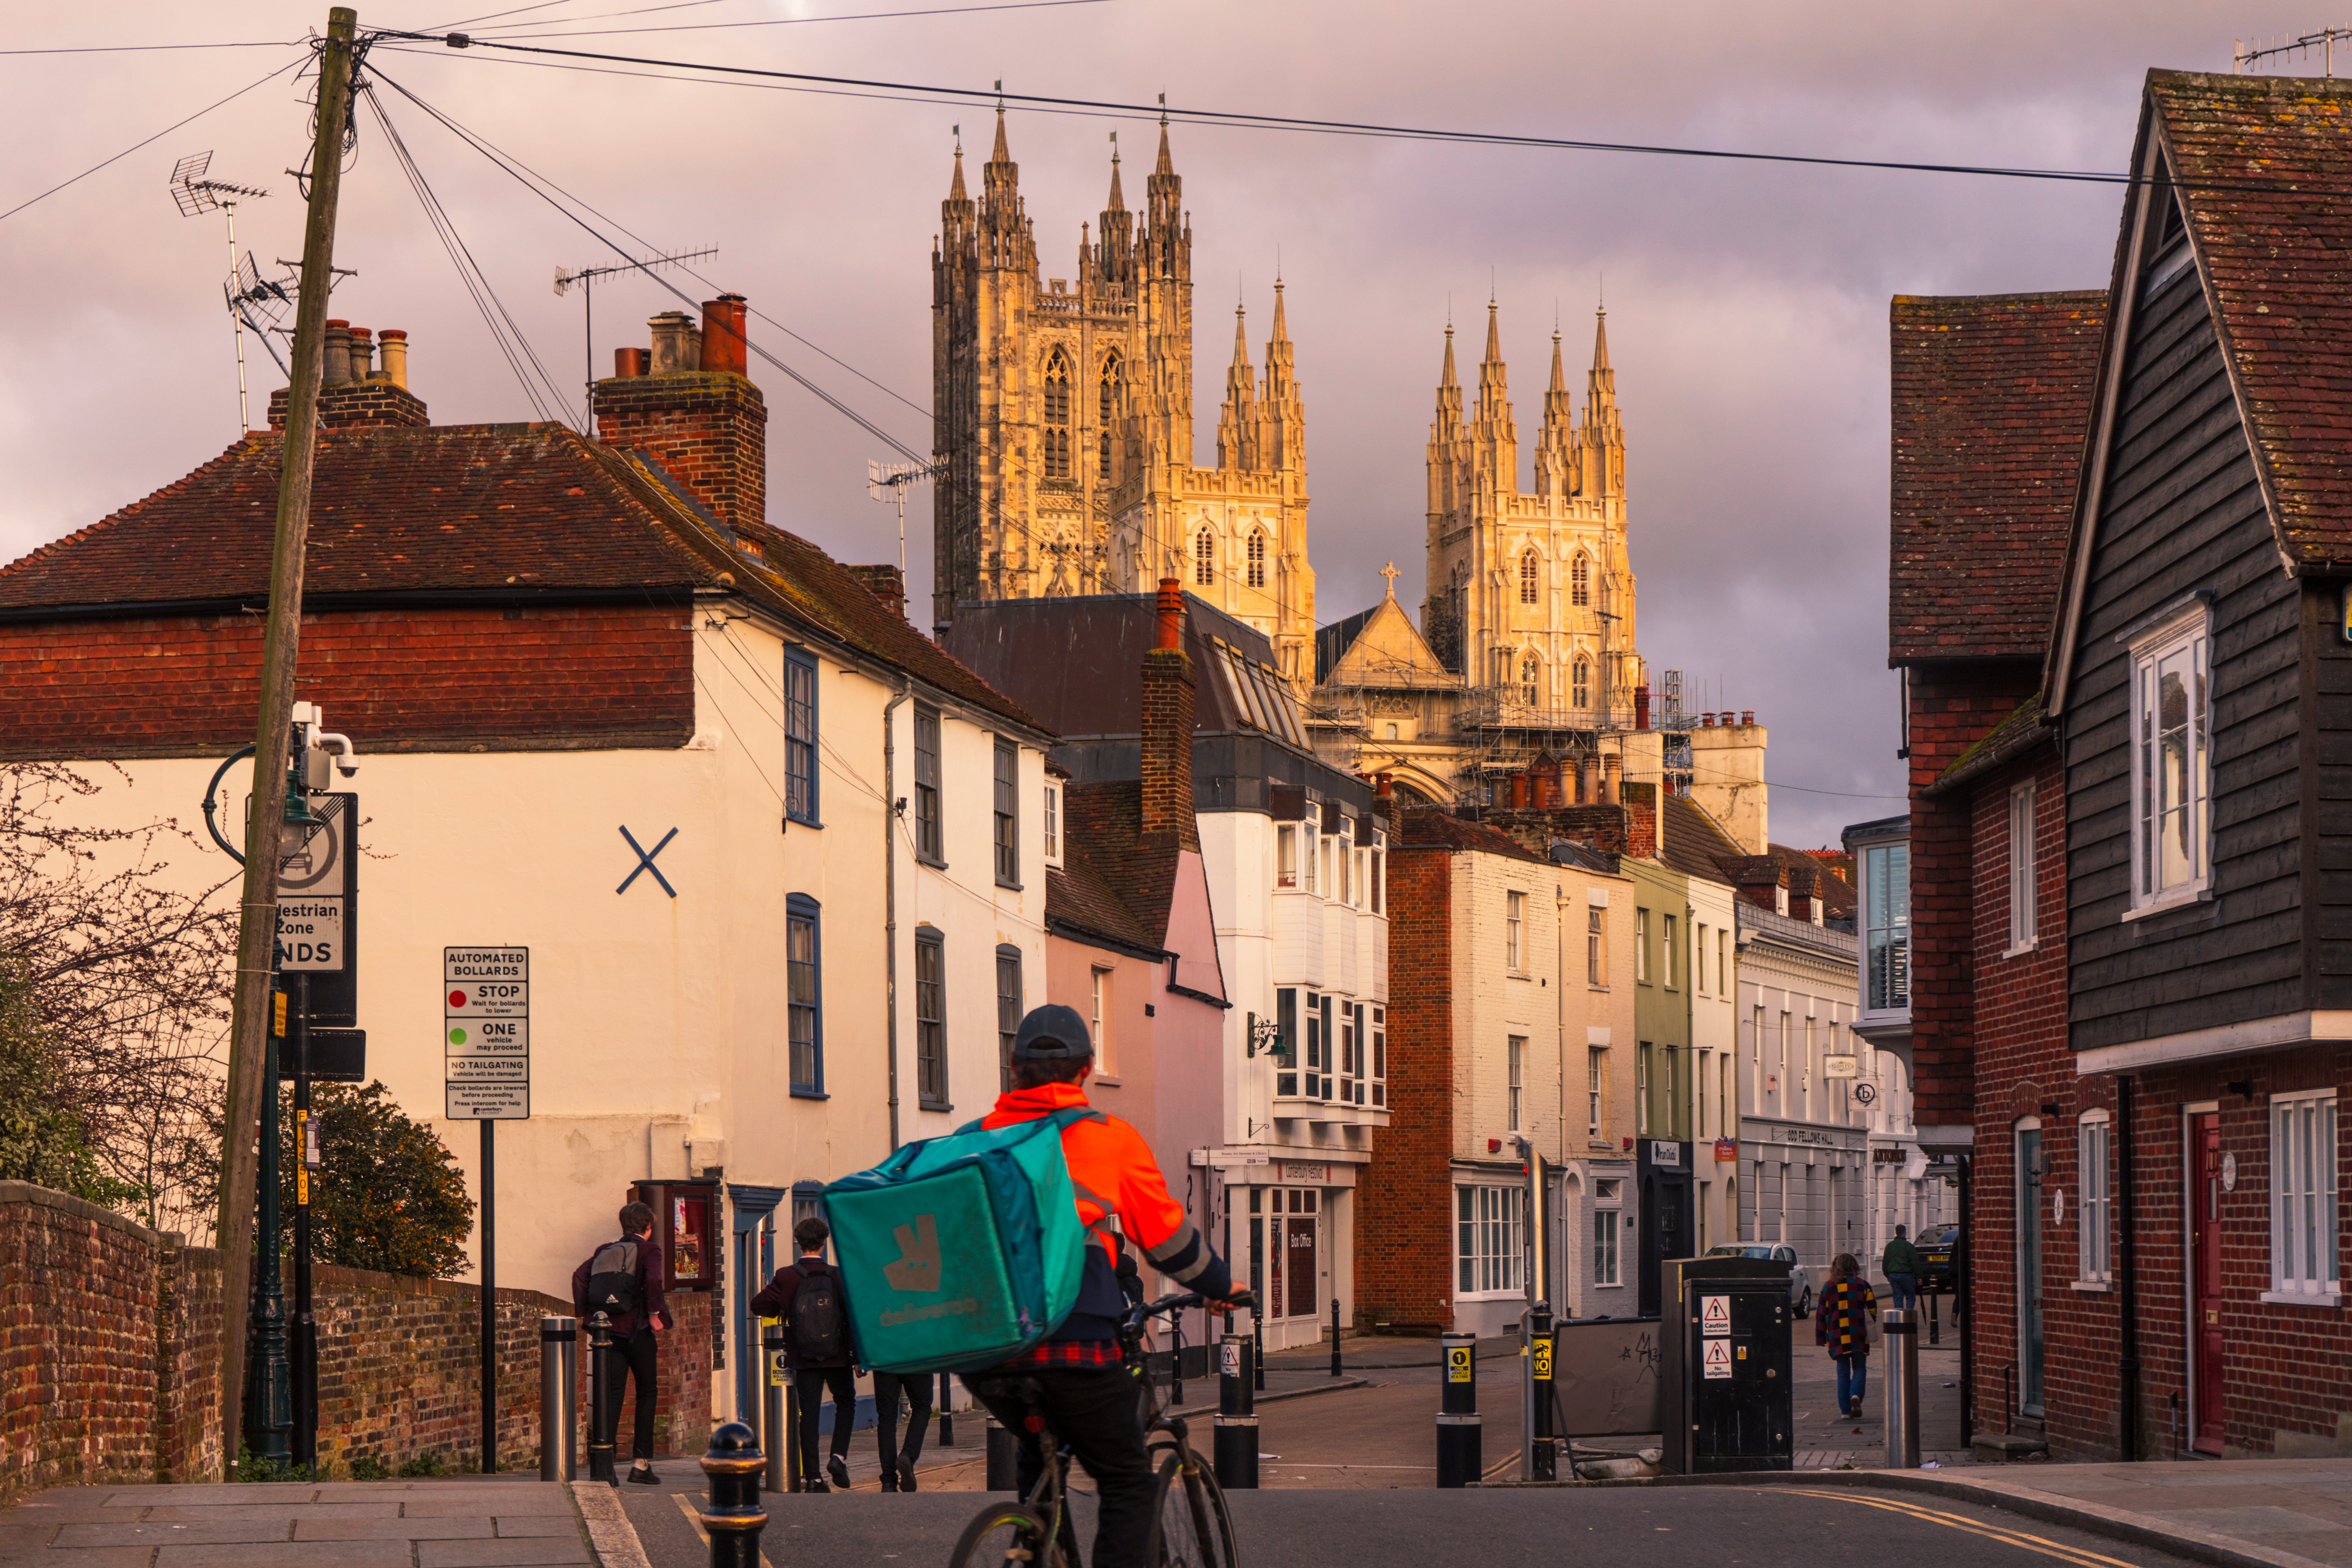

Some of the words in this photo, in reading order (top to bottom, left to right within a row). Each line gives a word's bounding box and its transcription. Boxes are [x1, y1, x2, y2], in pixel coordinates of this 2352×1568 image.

[278, 904, 338, 916] estrian
[283, 943, 331, 962] NDS
[449, 954, 524, 962] AUTOMATED
[455, 966, 519, 975] BOLLARDS
[479, 986, 519, 997] STOP
[483, 1023, 516, 1035] ONE
[1788, 1129, 1797, 1141] ODD
[1799, 1130, 1820, 1144] FELLOWS
[1822, 1133, 1833, 1145] HALL
[1286, 1163, 1308, 1182] Canterbury
[1308, 1164, 1323, 1179] Festival
[1318, 1212, 1321, 1227] 8
[1300, 1234, 1311, 1247] Office
[879, 1298, 978, 1327] deliveroo
[1456, 1354, 1461, 1363] 1
[1534, 1360, 1548, 1370] NO
